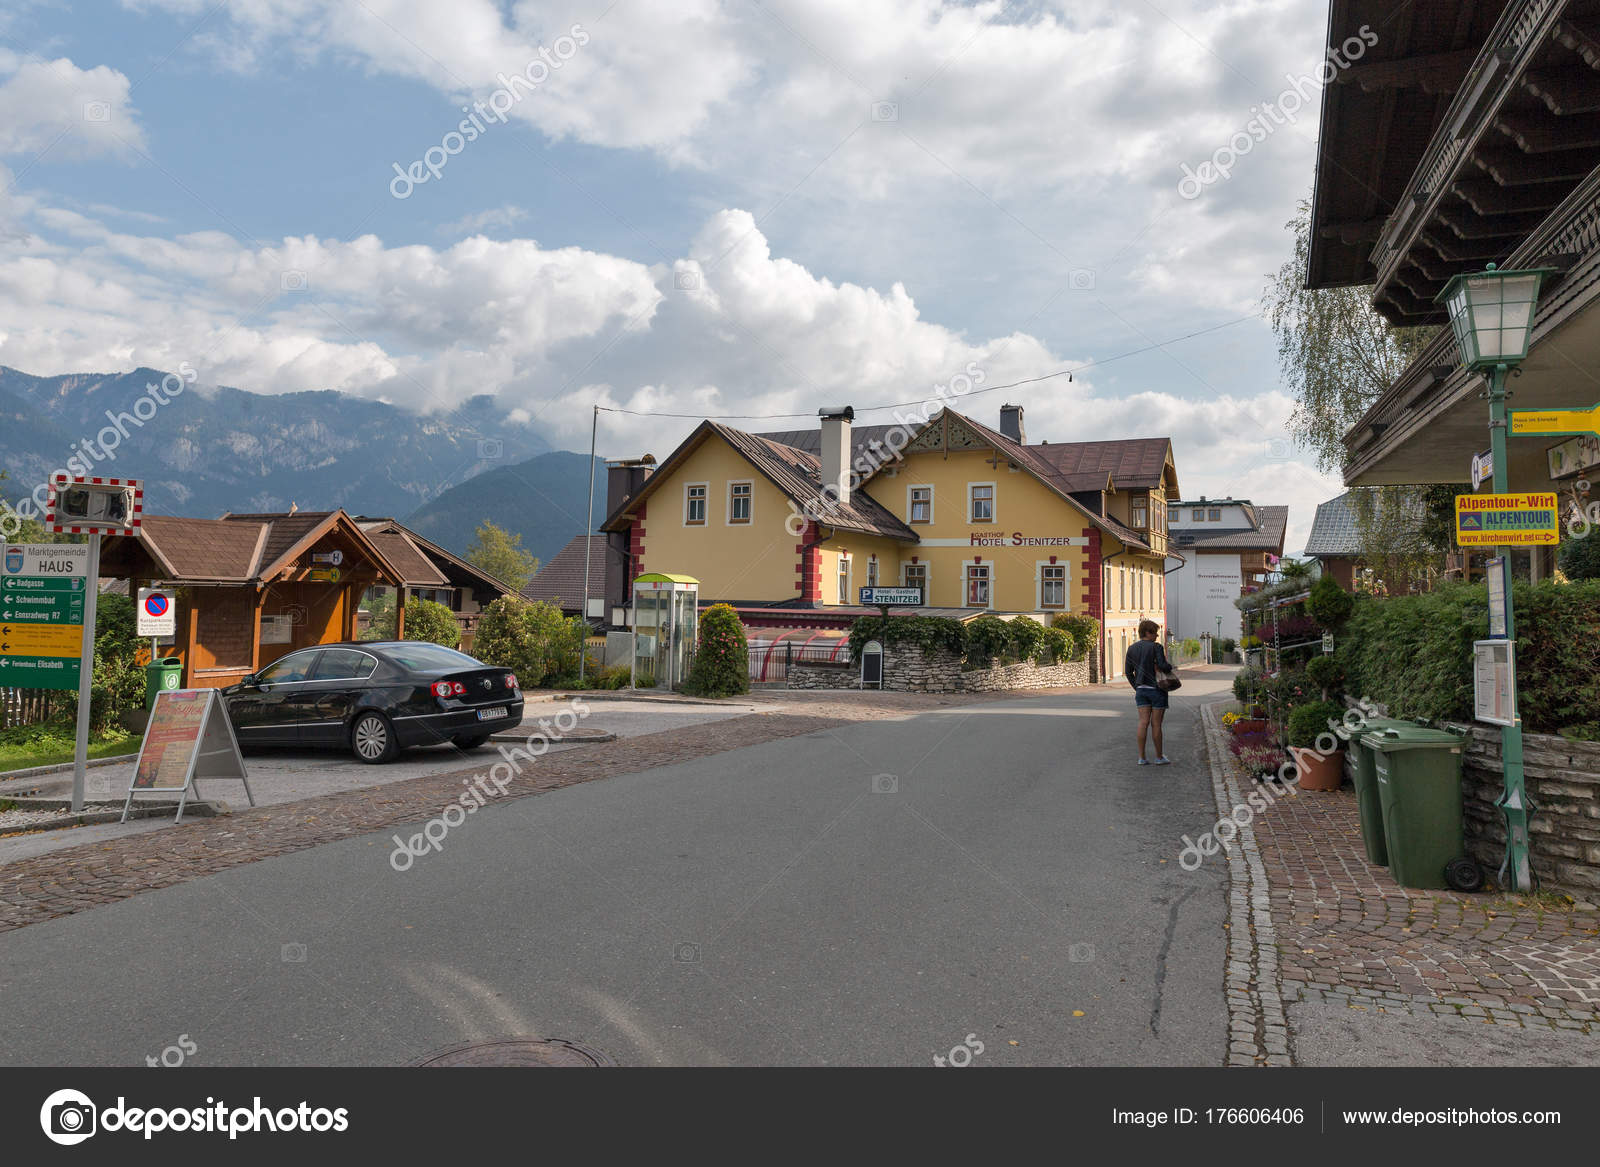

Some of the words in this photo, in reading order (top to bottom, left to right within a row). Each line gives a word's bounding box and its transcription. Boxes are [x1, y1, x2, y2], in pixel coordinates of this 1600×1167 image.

[1459, 495, 1554, 509] Alpentour-Wirt
[1486, 511, 1551, 524] ALPENTOUR
[970, 532, 1006, 547] HOTEL
[1012, 532, 1070, 546] STENITZER
[28, 547, 87, 558] Marktgemeinde
[39, 560, 73, 573] HAUS
[15, 595, 56, 604] Schwimmbad
[875, 595, 919, 603] STENITZER
